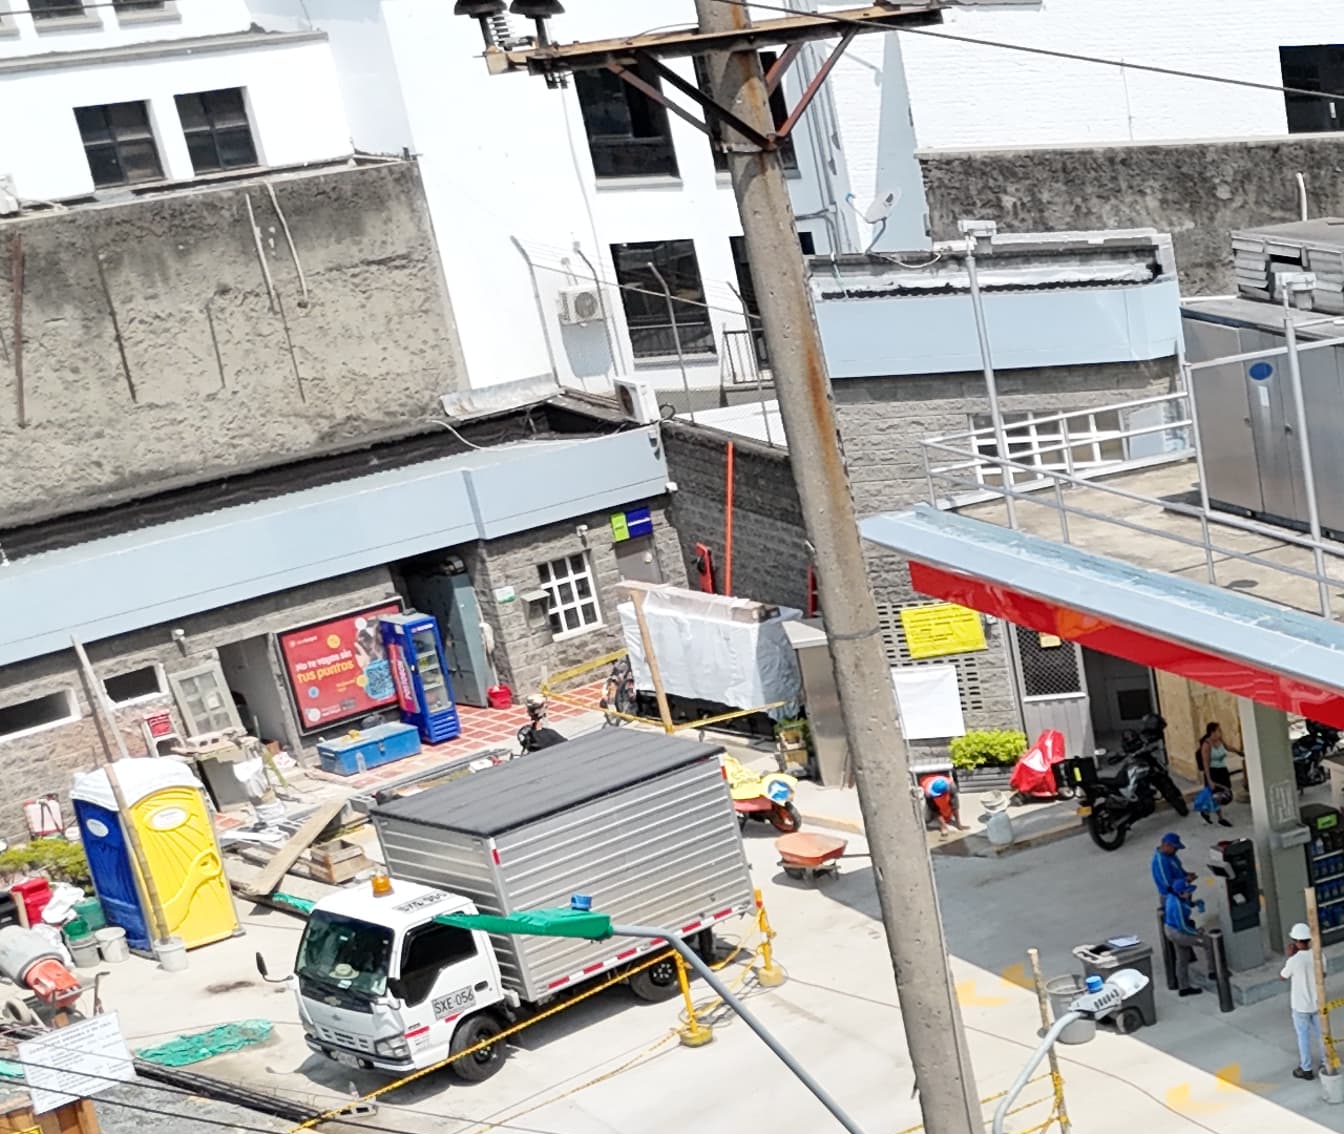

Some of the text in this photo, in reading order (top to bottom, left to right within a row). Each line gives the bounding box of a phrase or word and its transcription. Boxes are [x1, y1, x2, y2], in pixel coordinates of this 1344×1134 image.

[316, 659, 355, 681] puntos
[434, 989, 474, 1016] SXE 056
